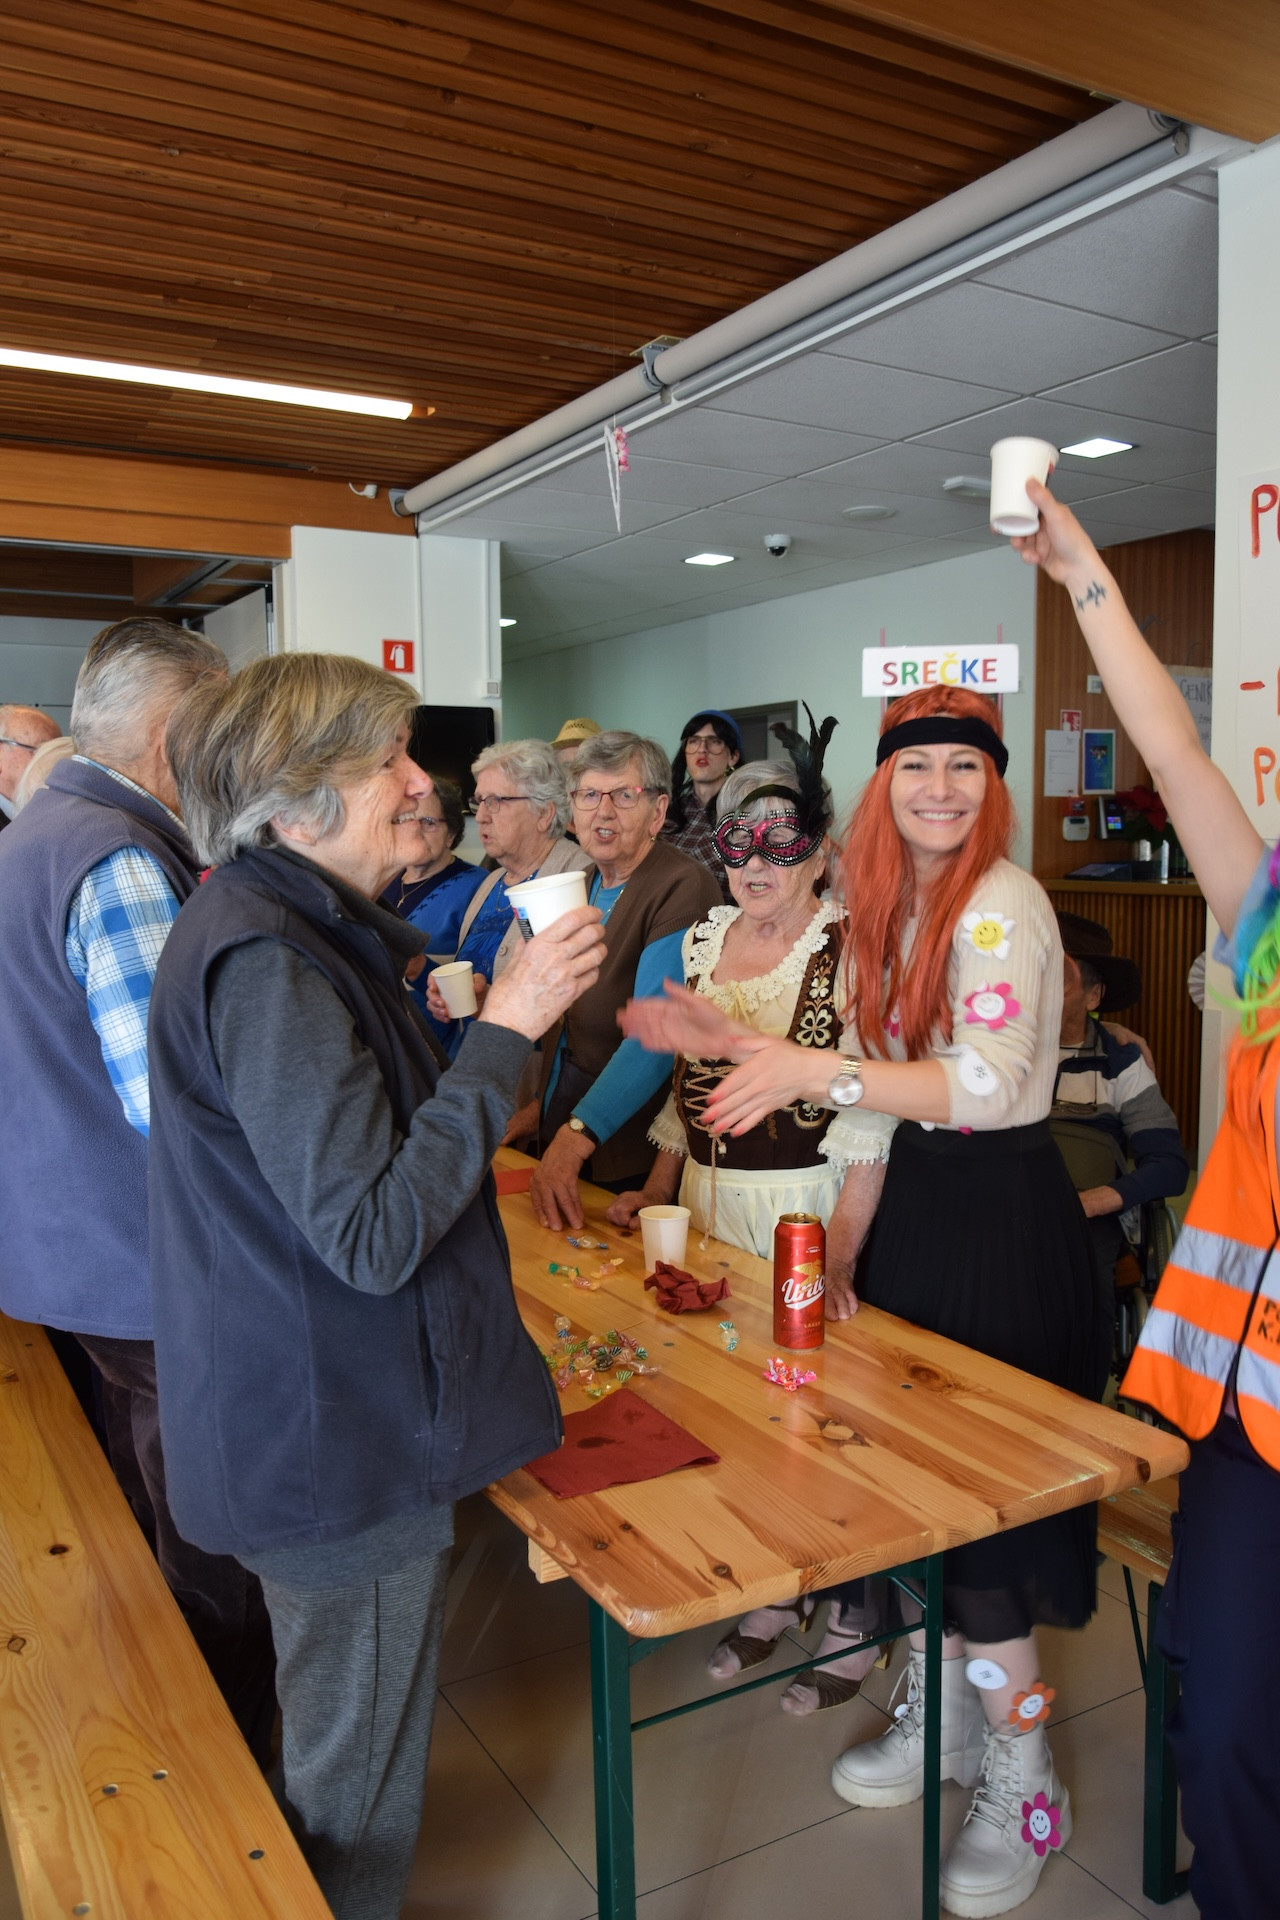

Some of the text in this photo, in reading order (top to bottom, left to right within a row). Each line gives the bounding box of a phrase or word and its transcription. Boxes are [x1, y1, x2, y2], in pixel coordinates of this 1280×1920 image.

[1250, 484, 1280, 559] P
[882, 652, 998, 686] SREČKE
[1253, 747, 1280, 807] P
